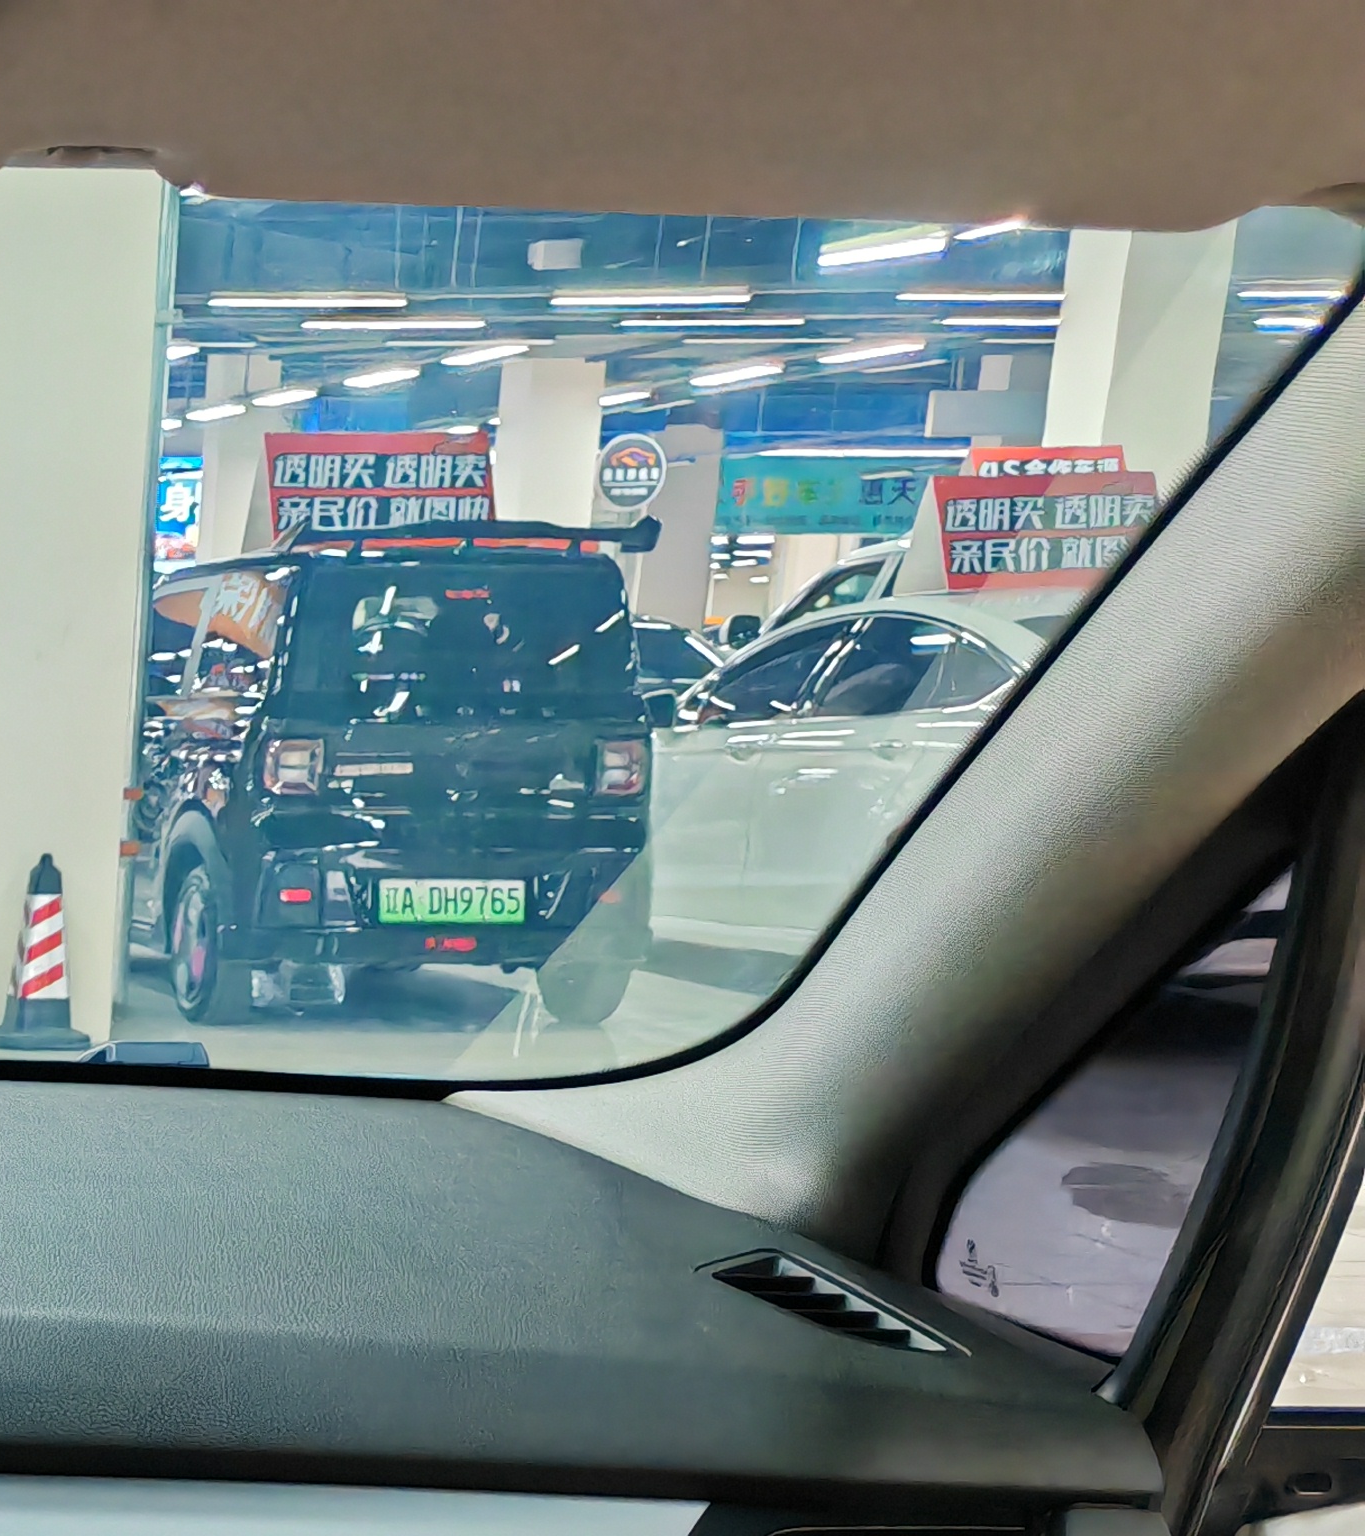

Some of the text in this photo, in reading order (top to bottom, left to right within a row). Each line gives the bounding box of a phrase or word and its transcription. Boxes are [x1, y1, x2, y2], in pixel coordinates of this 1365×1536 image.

[274, 454, 487, 488] 透明买 透明卖
[945, 496, 1045, 532] 透明买
[950, 536, 1051, 573] 亲民价
